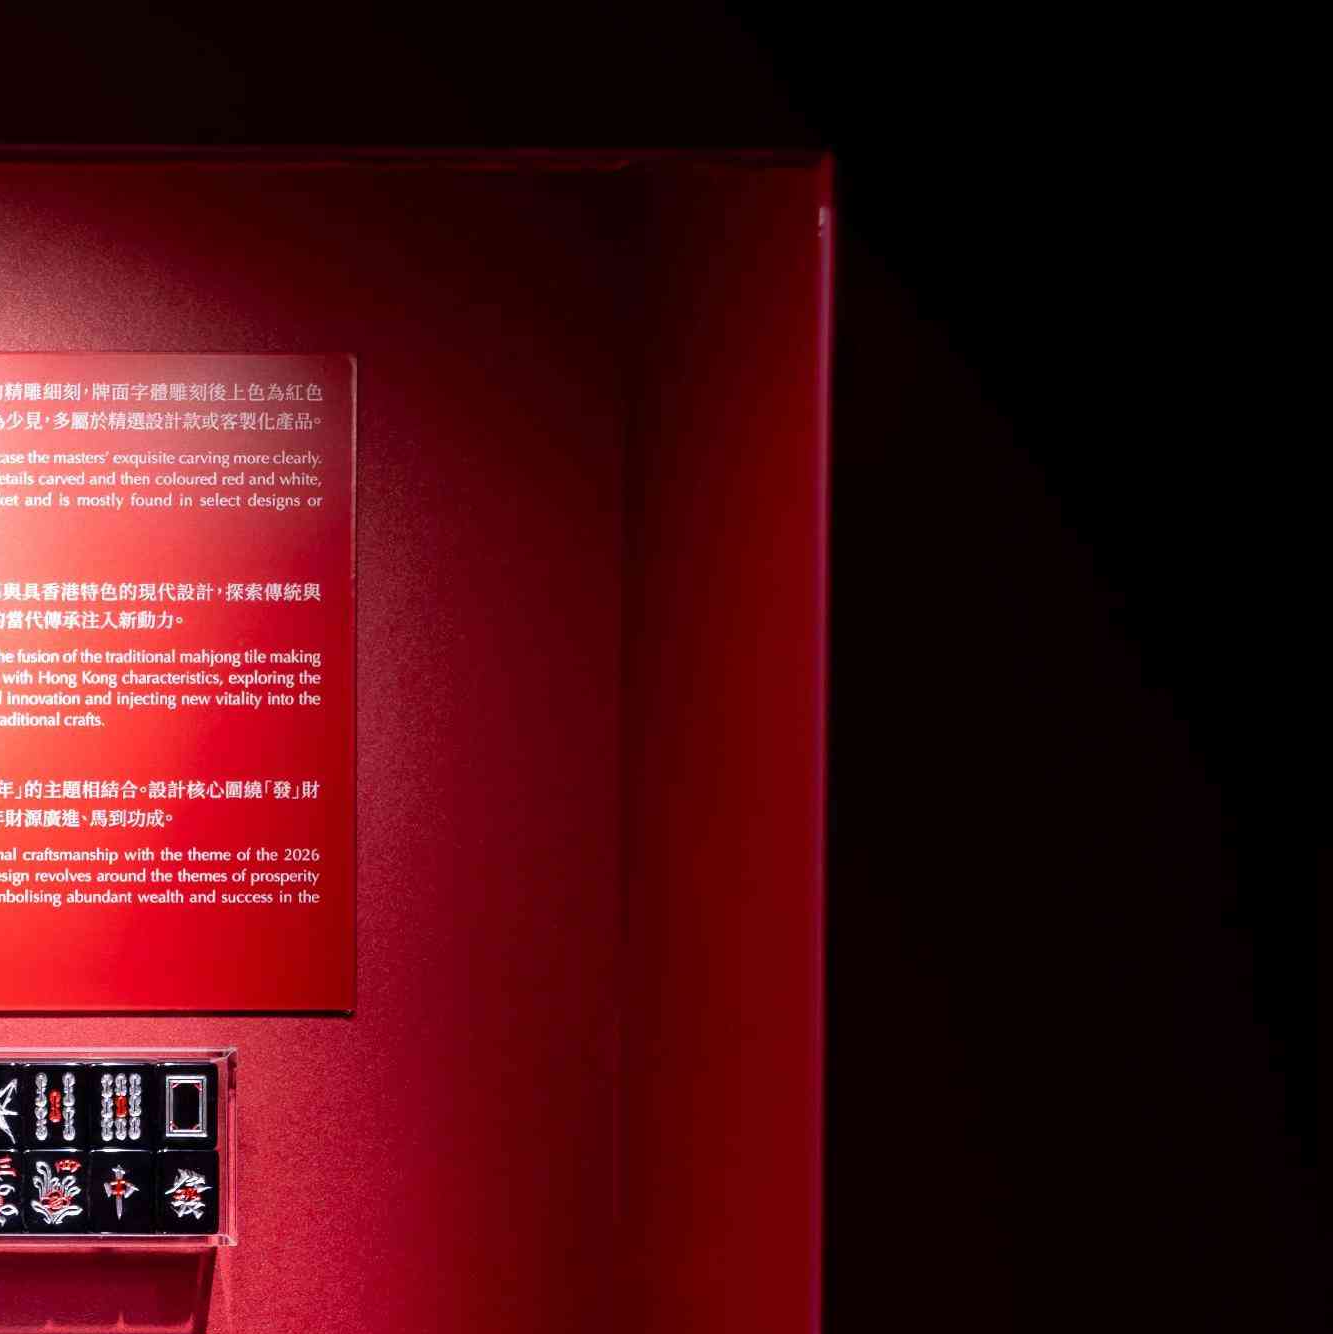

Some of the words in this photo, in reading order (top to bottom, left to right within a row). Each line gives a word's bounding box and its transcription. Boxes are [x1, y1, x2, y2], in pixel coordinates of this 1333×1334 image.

[112, 450, 176, 468] exquisite
[178, 450, 231, 468] carving
[233, 453, 272, 464] more
[272, 450, 324, 468] clearly.
[37, 471, 86, 485] carved
[89, 471, 117, 485] and
[119, 471, 151, 485] then
[154, 471, 218, 485] coloured
[221, 471, 245, 485] red
[248, 471, 276, 485] and
[279, 471, 323, 489] white,
[24, 492, 53, 506] and
[58, 492, 71, 506] is
[76, 492, 124, 510] mostly
[129, 492, 174, 506] found
[179, 492, 193, 506] in
[199, 492, 242, 506] select
[247, 492, 301, 510] designs
[306, 495, 324, 506] or
[16, 649, 61, 663] fusion
[61, 649, 78, 663] of
[79, 649, 103, 663] the
[104, 649, 177, 663] traditional
[179, 649, 242, 667] mahjong
[244, 649, 267, 663] tile
[269, 649, 322, 667] making
[37, 670, 78, 688] Hong
[81, 670, 118, 688] Kong
[121, 670, 224, 688] characteristics,
[228, 670, 295, 688] exploring
[298, 670, 321, 684] the
[6, 691, 81, 705] innovation
[84, 691, 113, 705] and
[116, 691, 177, 709] injecting
[181, 694, 211, 705] new
[215, 691, 262, 709] vitality
[267, 691, 294, 705] into
[298, 691, 321, 705] the
[63, 712, 106, 726] crafts.
[22, 847, 119, 864] craftsmanship
[124, 847, 155, 860] with
[160, 847, 183, 860] the
[187, 847, 232, 860] theme
[236, 847, 252, 860] of
[256, 847, 278, 860] the
[284, 847, 320, 860] 2026
[34, 868, 92, 882] revolves
[96, 868, 147, 882] around
[150, 868, 173, 882] the
[177, 868, 228, 882] themes
[231, 868, 247, 882] of
[249, 868, 320, 885] prosperity
[66, 890, 133, 904] abundant
[137, 890, 185, 904] wealth
[189, 890, 217, 904] and
[221, 893, 273, 904] success
[279, 890, 293, 904] in
[298, 890, 320, 904] the
